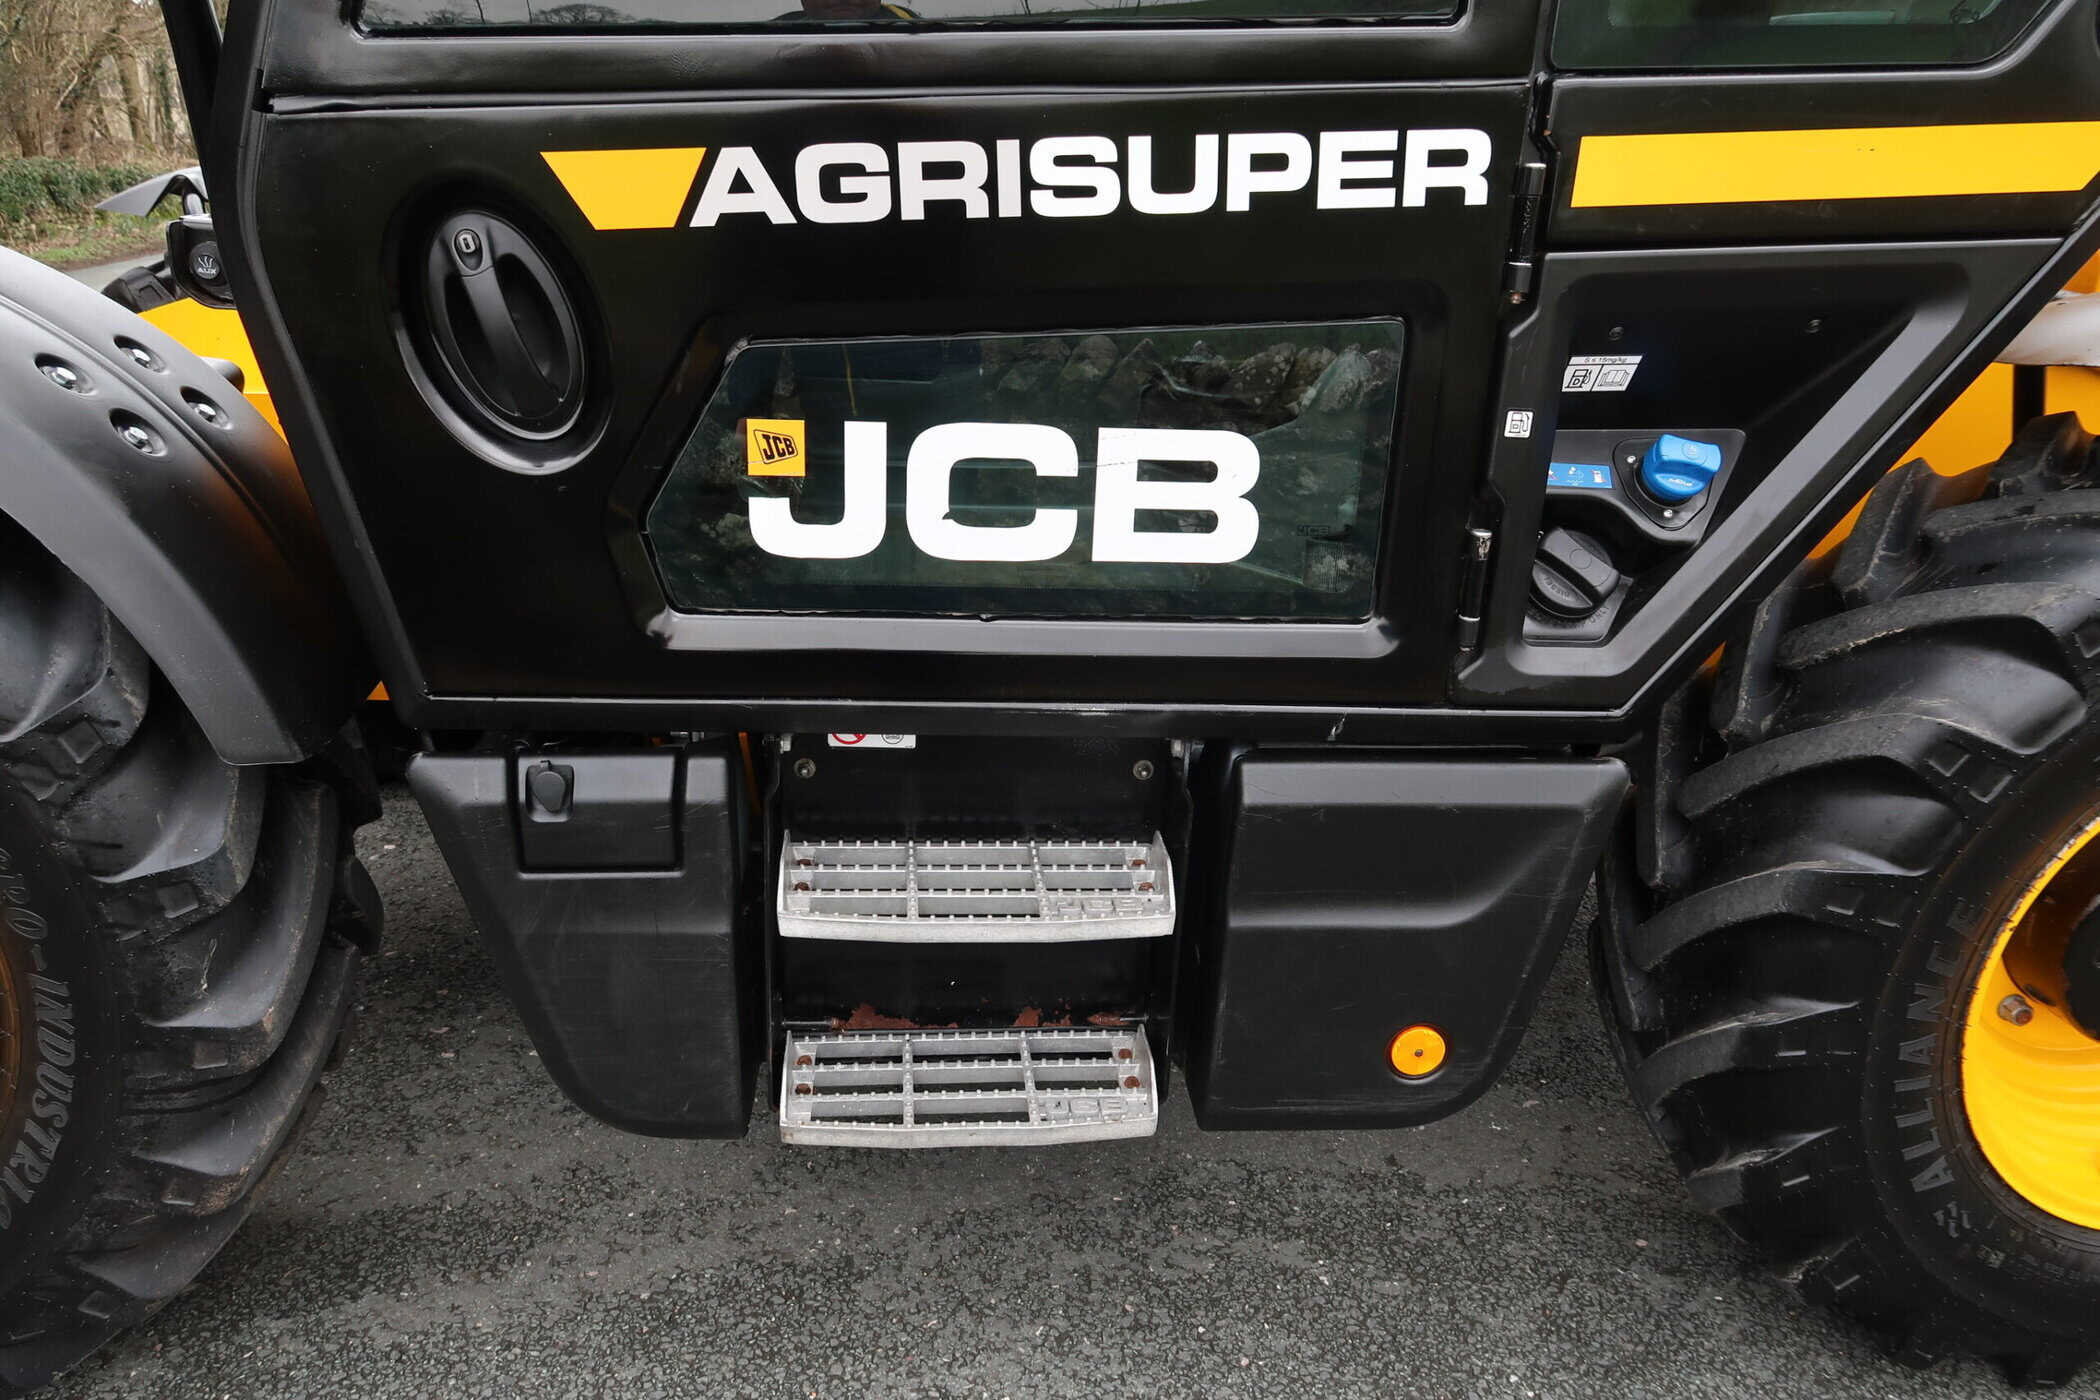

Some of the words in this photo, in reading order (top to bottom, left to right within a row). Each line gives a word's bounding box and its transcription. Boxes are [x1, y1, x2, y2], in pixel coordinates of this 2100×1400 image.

[689, 128, 1489, 227] AGRISUPER
[197, 267, 217, 275] AUX
[748, 421, 1260, 563] JCB
[762, 434, 795, 461] JCB
[1894, 899, 1980, 1192] ALLIANCE
